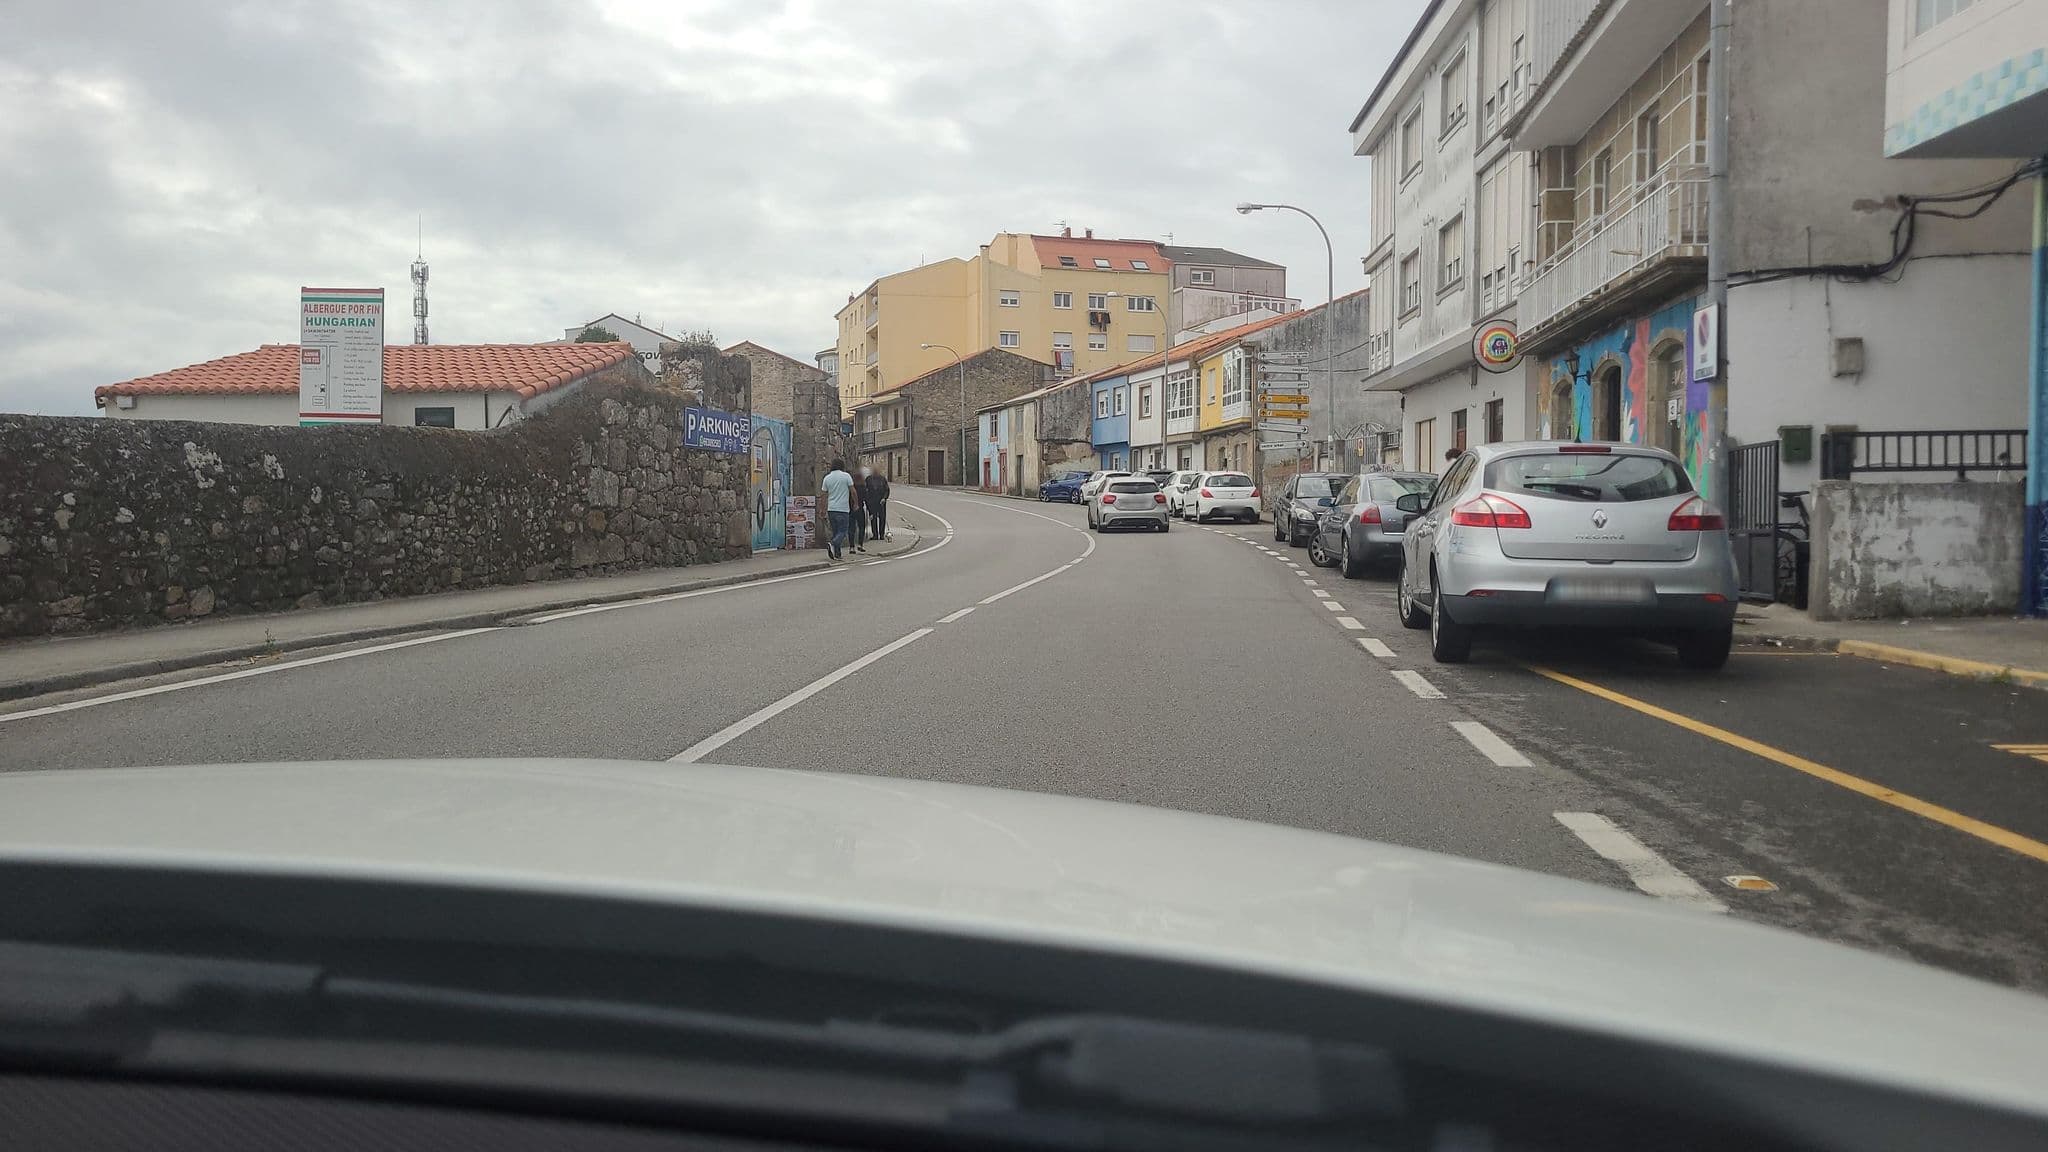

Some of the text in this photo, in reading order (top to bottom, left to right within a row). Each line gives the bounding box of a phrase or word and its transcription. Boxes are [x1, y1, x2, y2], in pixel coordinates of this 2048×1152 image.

[303, 304, 380, 315] ALBERGUE POR FIN
[305, 316, 376, 327] HUNGARIAN
[688, 413, 740, 439] PARKING
